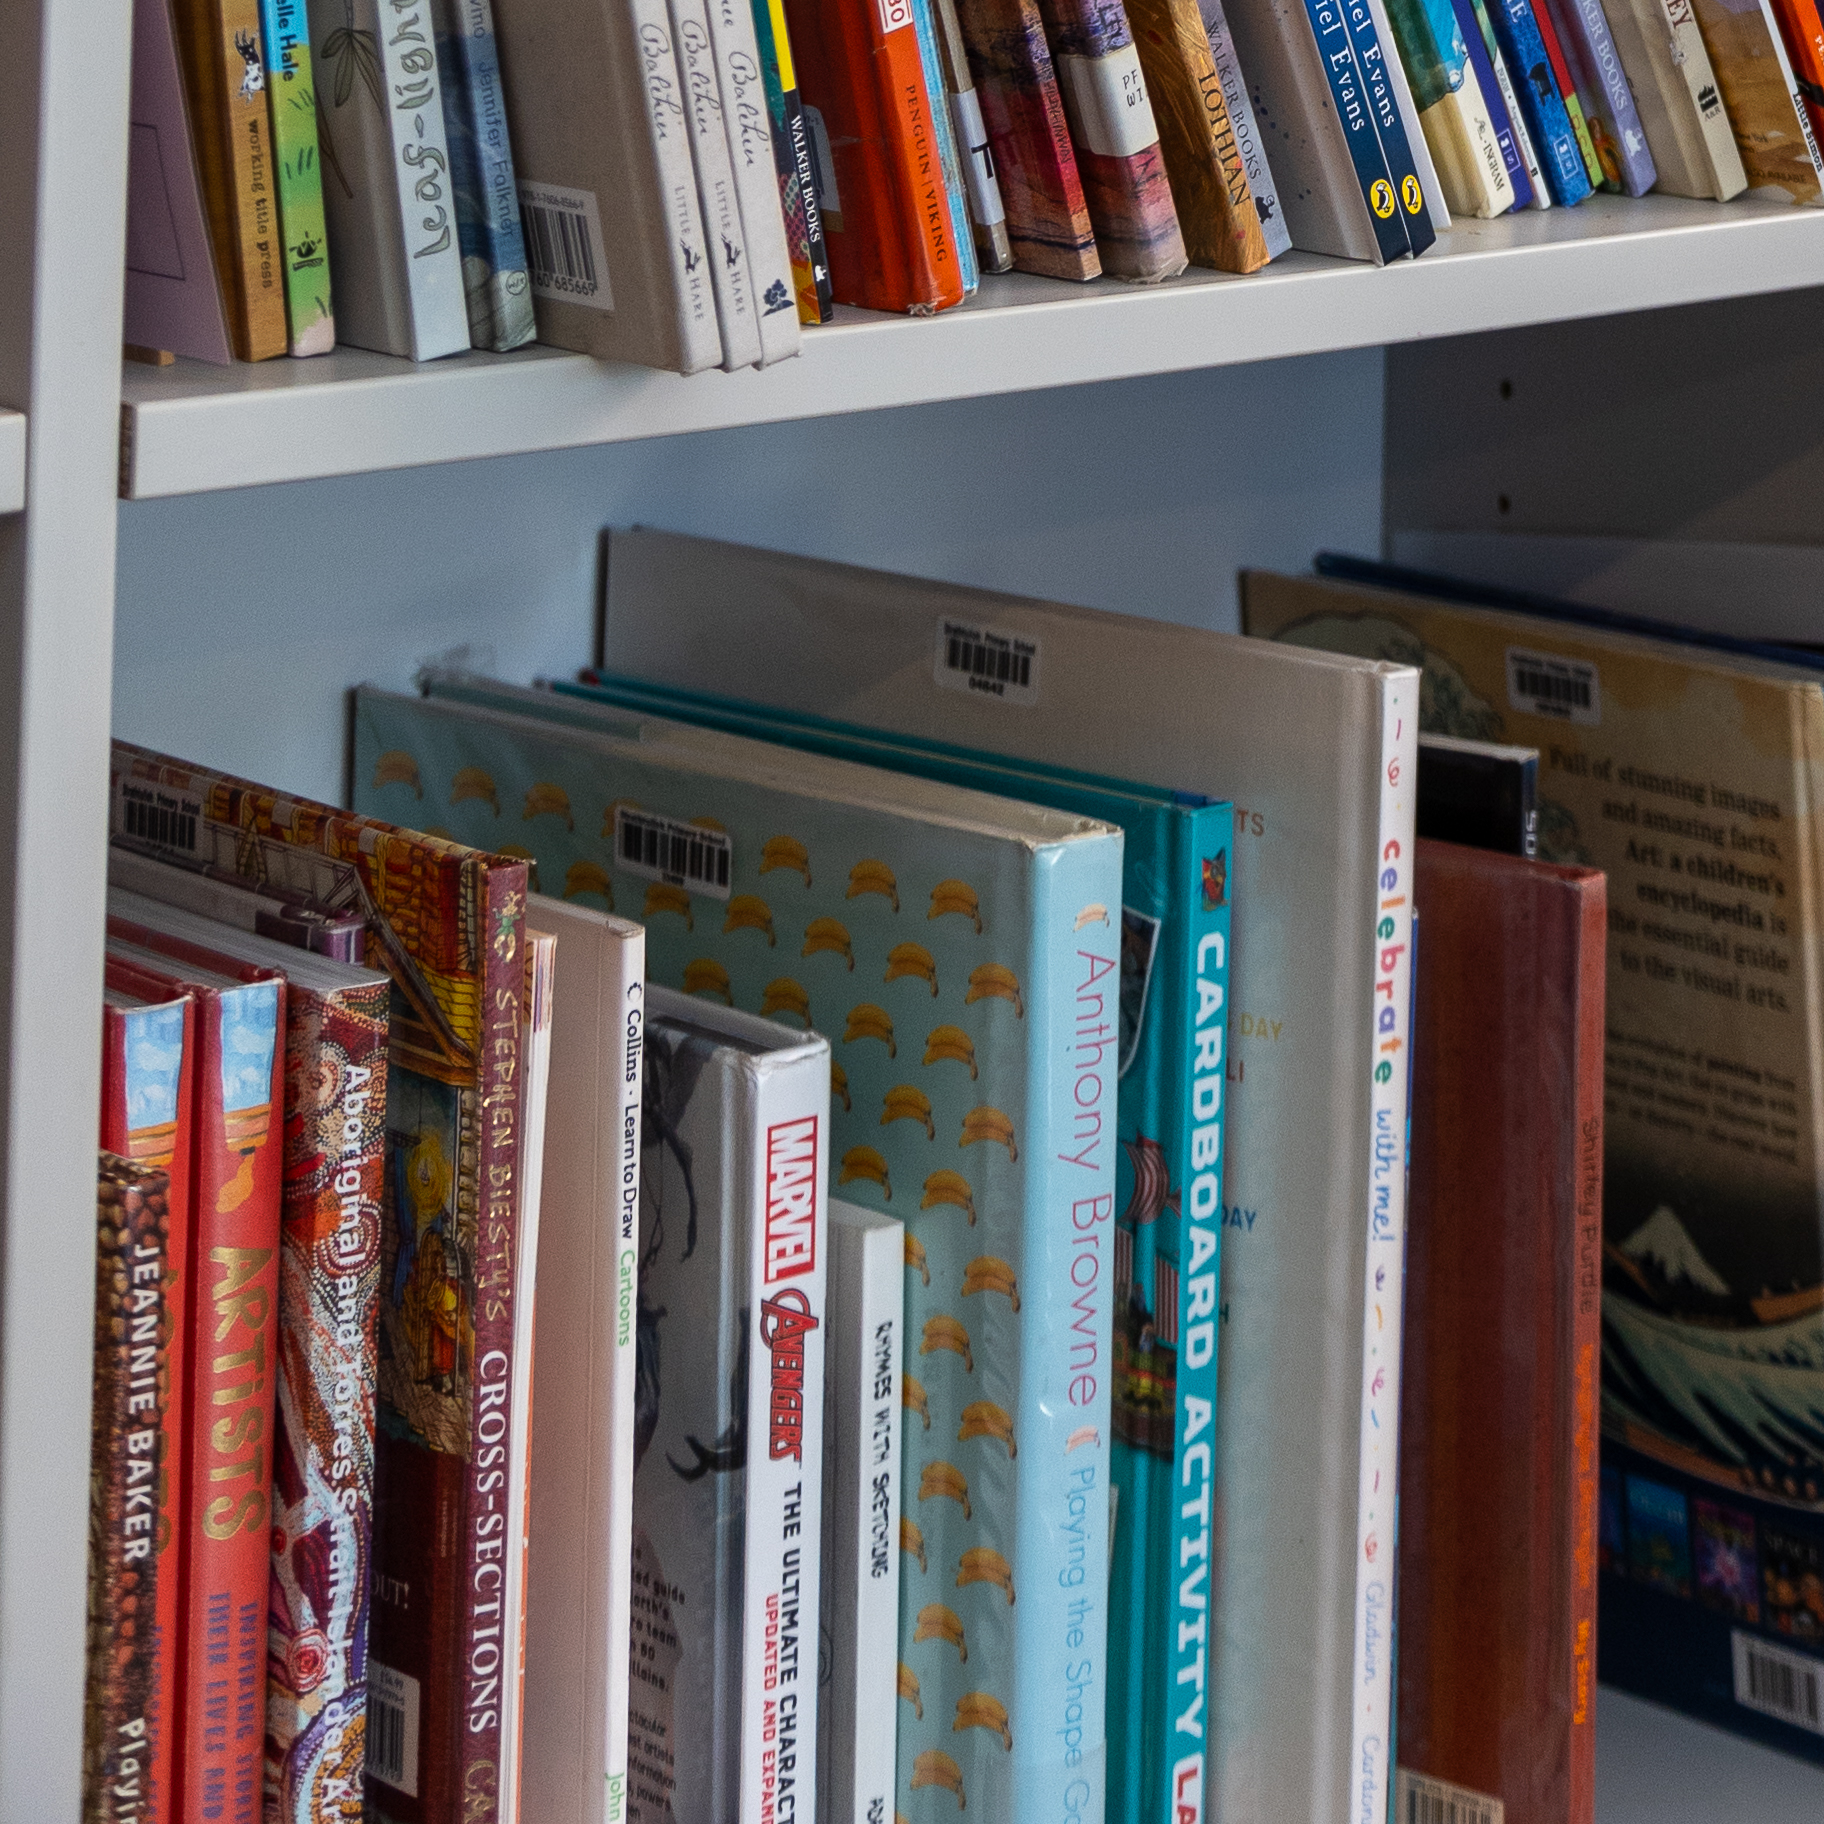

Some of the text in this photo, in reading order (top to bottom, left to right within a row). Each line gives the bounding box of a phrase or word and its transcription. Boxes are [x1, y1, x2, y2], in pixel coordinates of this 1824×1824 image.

[280, 33, 301, 83] Hale
[1197, 70, 1251, 207] LOTHIAN
[1329, 48, 1366, 133] Evans
[248, 118, 273, 289] working title press
[478, 61, 516, 238] Jennifer Falkner
[789, 113, 821, 244] WALKER BOOKS
[904, 84, 948, 264] PENGUIN VIKING
[1617, 763, 1707, 805] stunning
[1711, 787, 1781, 824] images
[1636, 880, 1787, 936] encyclopedia is
[483, 986, 519, 1149] STEPHEN
[1239, 1013, 1284, 1042] DAY
[1372, 838, 1406, 1242] celebrate with me!
[334, 1063, 374, 1262] Aboriginal
[764, 1116, 818, 1284] MARVEL
[1057, 949, 1118, 1408] Anthony Browne
[1185, 931, 1226, 1371] CARDBOARD
[1576, 1118, 1600, 1215] Shirley
[125, 1243, 162, 1417] JEANNIE
[334, 1274, 364, 1348] and
[1578, 1221, 1601, 1316] Purdie
[333, 1350, 363, 1480] Torres
[604, 1008, 644, 1823] Collins Learn to Draw Cartoons John
[760, 1288, 819, 1468] AVENGERS
[121, 1426, 154, 1565] BAKER
[328, 1485, 358, 1596] Strait
[468, 1349, 509, 1735] CROSS-SECTIONS
[782, 1480, 802, 1540] THE
[1175, 1394, 1213, 1740] ACTIVITY
[322, 1602, 354, 1772] Islander
[779, 1545, 802, 1687] ULTIMATE
[1055, 1464, 1096, 1769] Playing the Shape
[200, 1592, 231, 1820] THEIR LIVES AND
